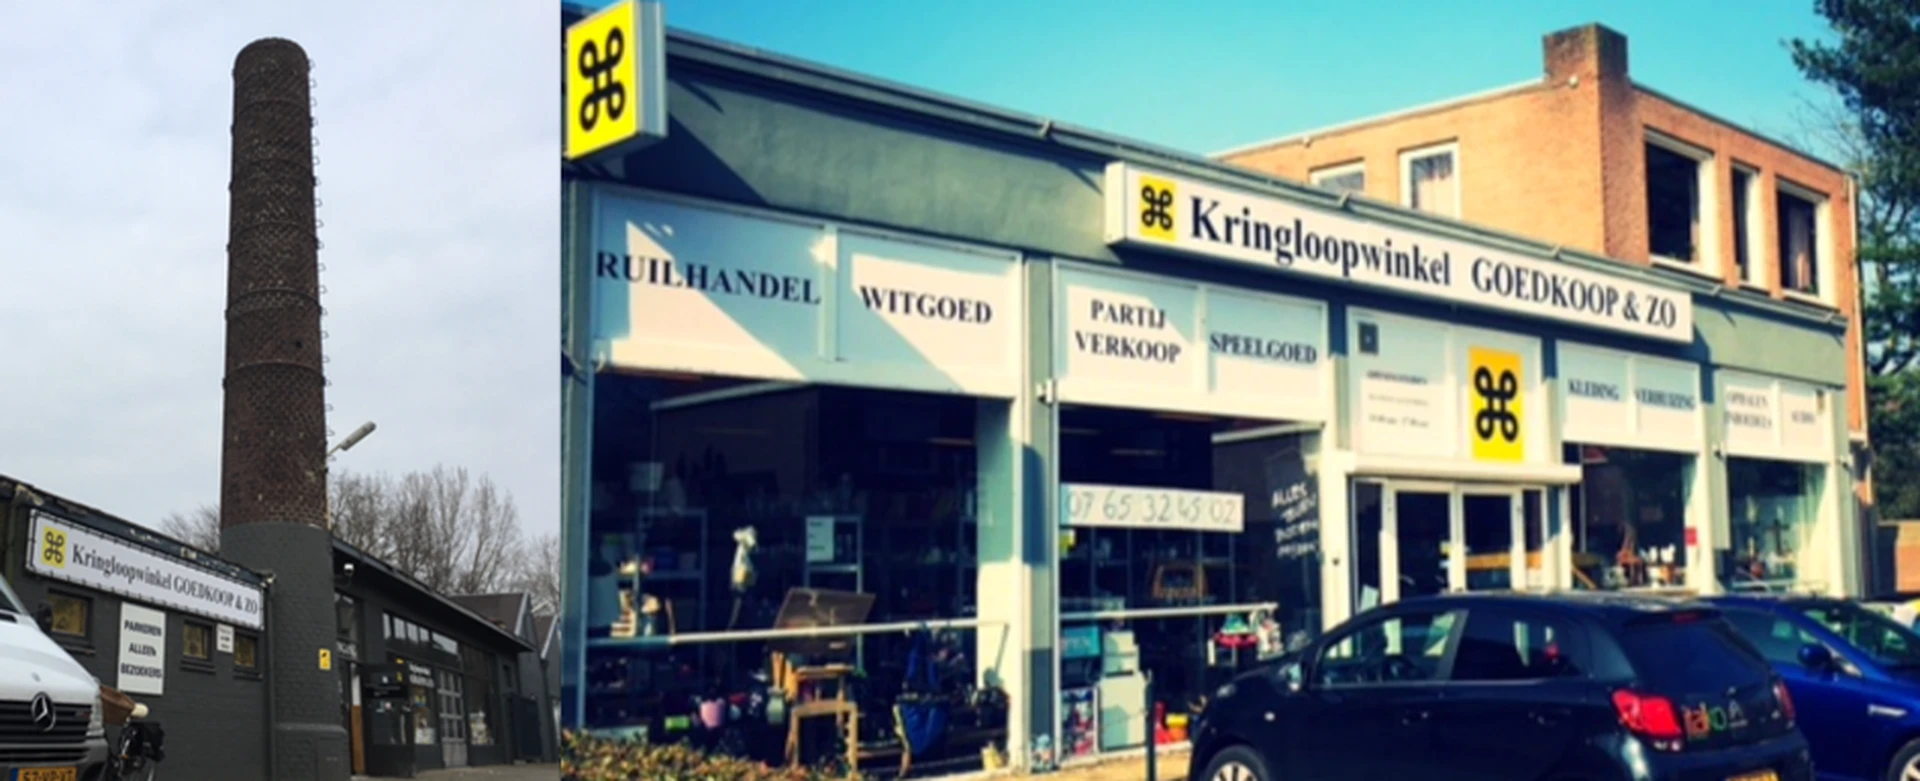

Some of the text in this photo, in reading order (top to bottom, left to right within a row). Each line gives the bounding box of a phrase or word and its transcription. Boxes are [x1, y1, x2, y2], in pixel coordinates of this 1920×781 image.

[597, 251, 821, 306] RUILHANDEL
[1190, 195, 1677, 330] Kringloopwinkel GOEDKOOP & ZO
[860, 285, 993, 325] WITGOED
[1090, 298, 1166, 330] PARTIJ
[1075, 330, 1182, 365] VERKOOP
[1210, 331, 1317, 365] SPEELGOED
[1568, 379, 1620, 401] KLEDING
[1103, 490, 1133, 521] 65
[1141, 493, 1171, 522] 32
[1209, 497, 1237, 524] 02
[72, 543, 258, 614] Kringloopwinkel GOEDKOOP & ZO
[124, 619, 162, 637] PARKEREN
[128, 642, 157, 657] ALLEEN
[120, 662, 162, 679] BEZOEKERS
